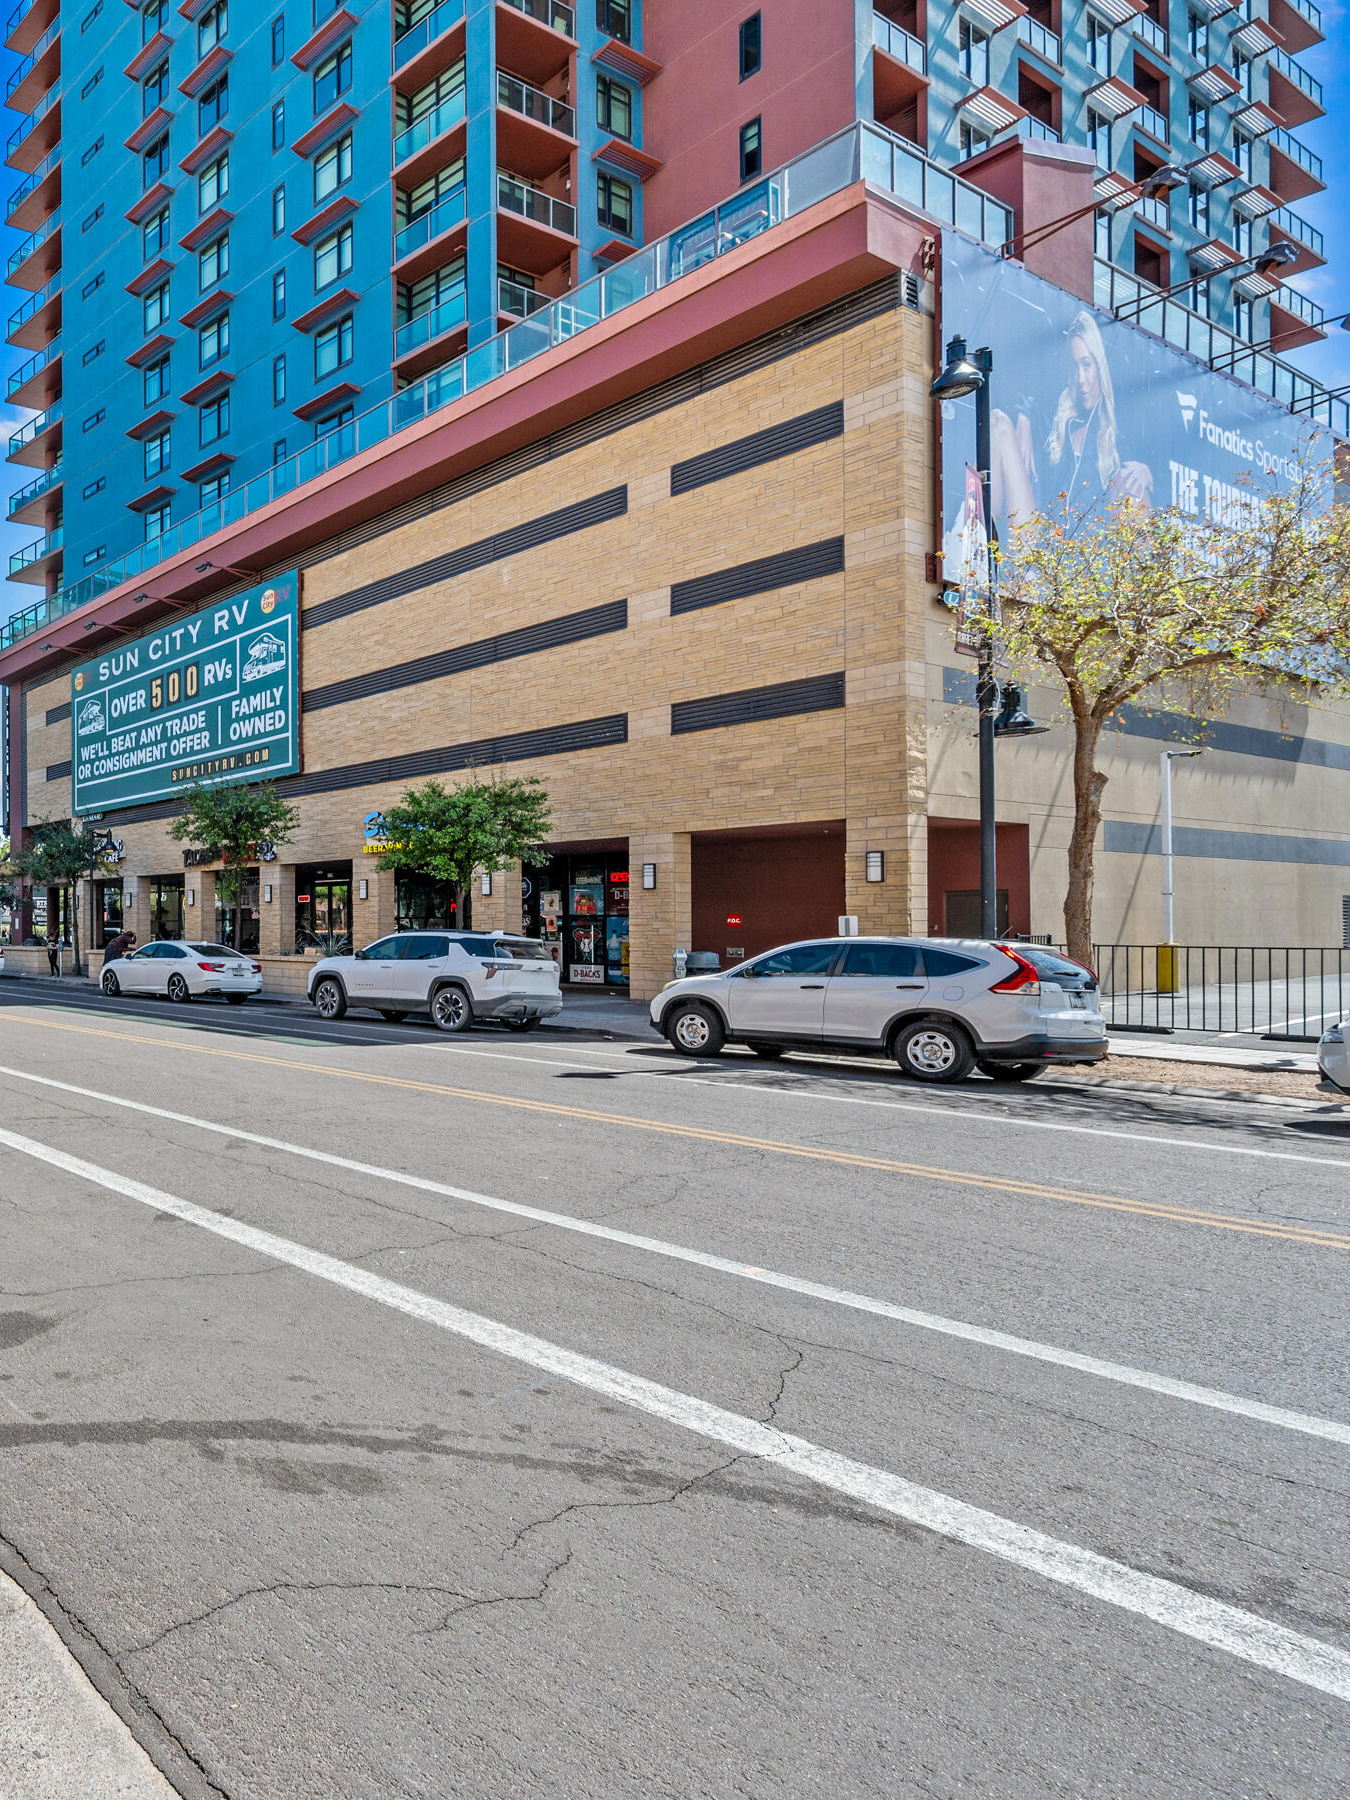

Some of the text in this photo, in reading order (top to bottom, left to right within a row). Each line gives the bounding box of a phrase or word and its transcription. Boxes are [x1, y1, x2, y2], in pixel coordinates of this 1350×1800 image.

[1199, 409, 1254, 462] Fanatics
[1169, 460, 1199, 515] THE
[99, 599, 249, 681] SUN CITY RV
[110, 657, 233, 718] OVER 500 RVs
[231, 685, 284, 719] FAMILY
[80, 710, 206, 762] WE'LL BEAT ANY TRADE
[229, 709, 286, 741] OWNED
[78, 731, 210, 780] OR CONSIGNMENT OFFER
[171, 748, 269, 782] SUNCITYRV.COM
[573, 969, 601, 979] D-BACKS
